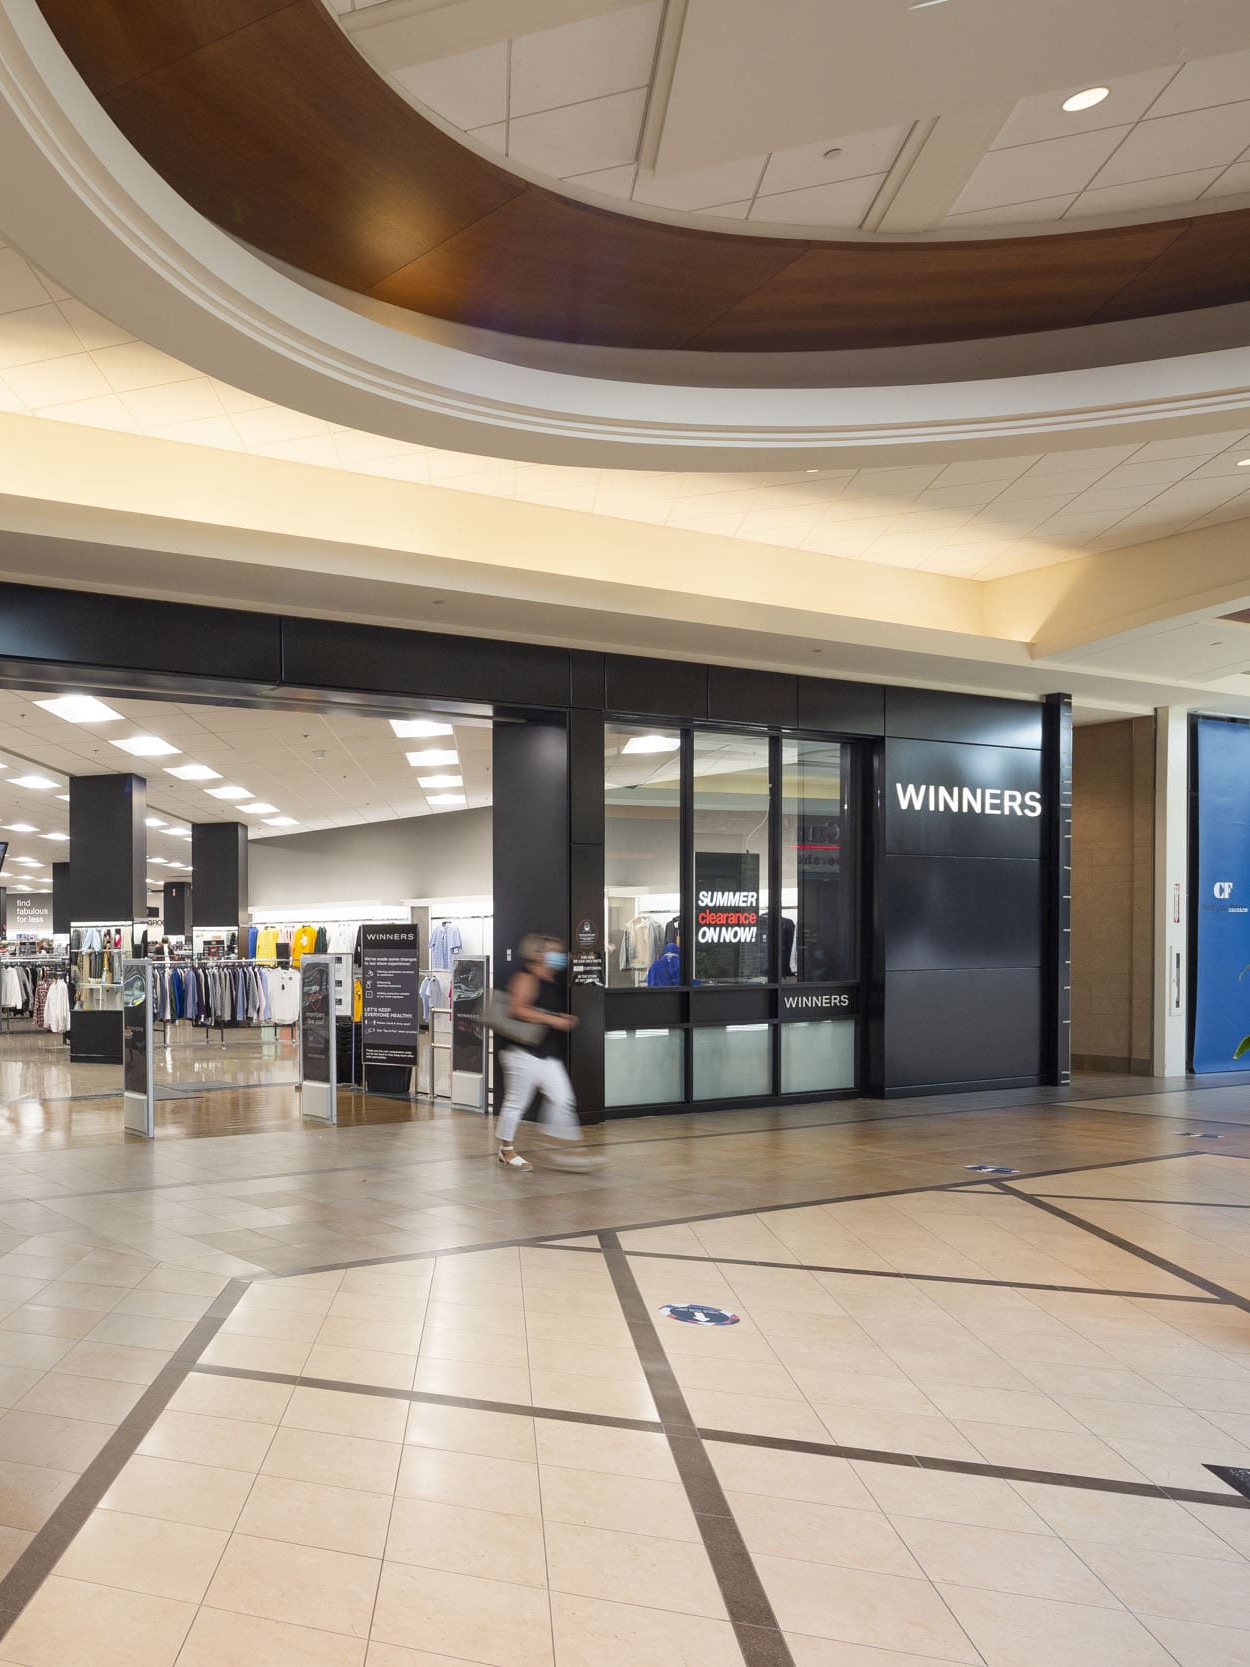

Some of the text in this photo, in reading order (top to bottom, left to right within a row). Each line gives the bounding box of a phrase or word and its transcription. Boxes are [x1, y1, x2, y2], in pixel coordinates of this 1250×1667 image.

[896, 783, 1042, 817] WINNERS
[1213, 882, 1233, 899] CF
[16, 899, 31, 907] find
[698, 891, 757, 907] SUMMER
[16, 907, 49, 915] fabulous
[698, 909, 757, 925] clearance
[698, 926, 757, 943] ON NOW!
[784, 994, 849, 1009] WINNERS
